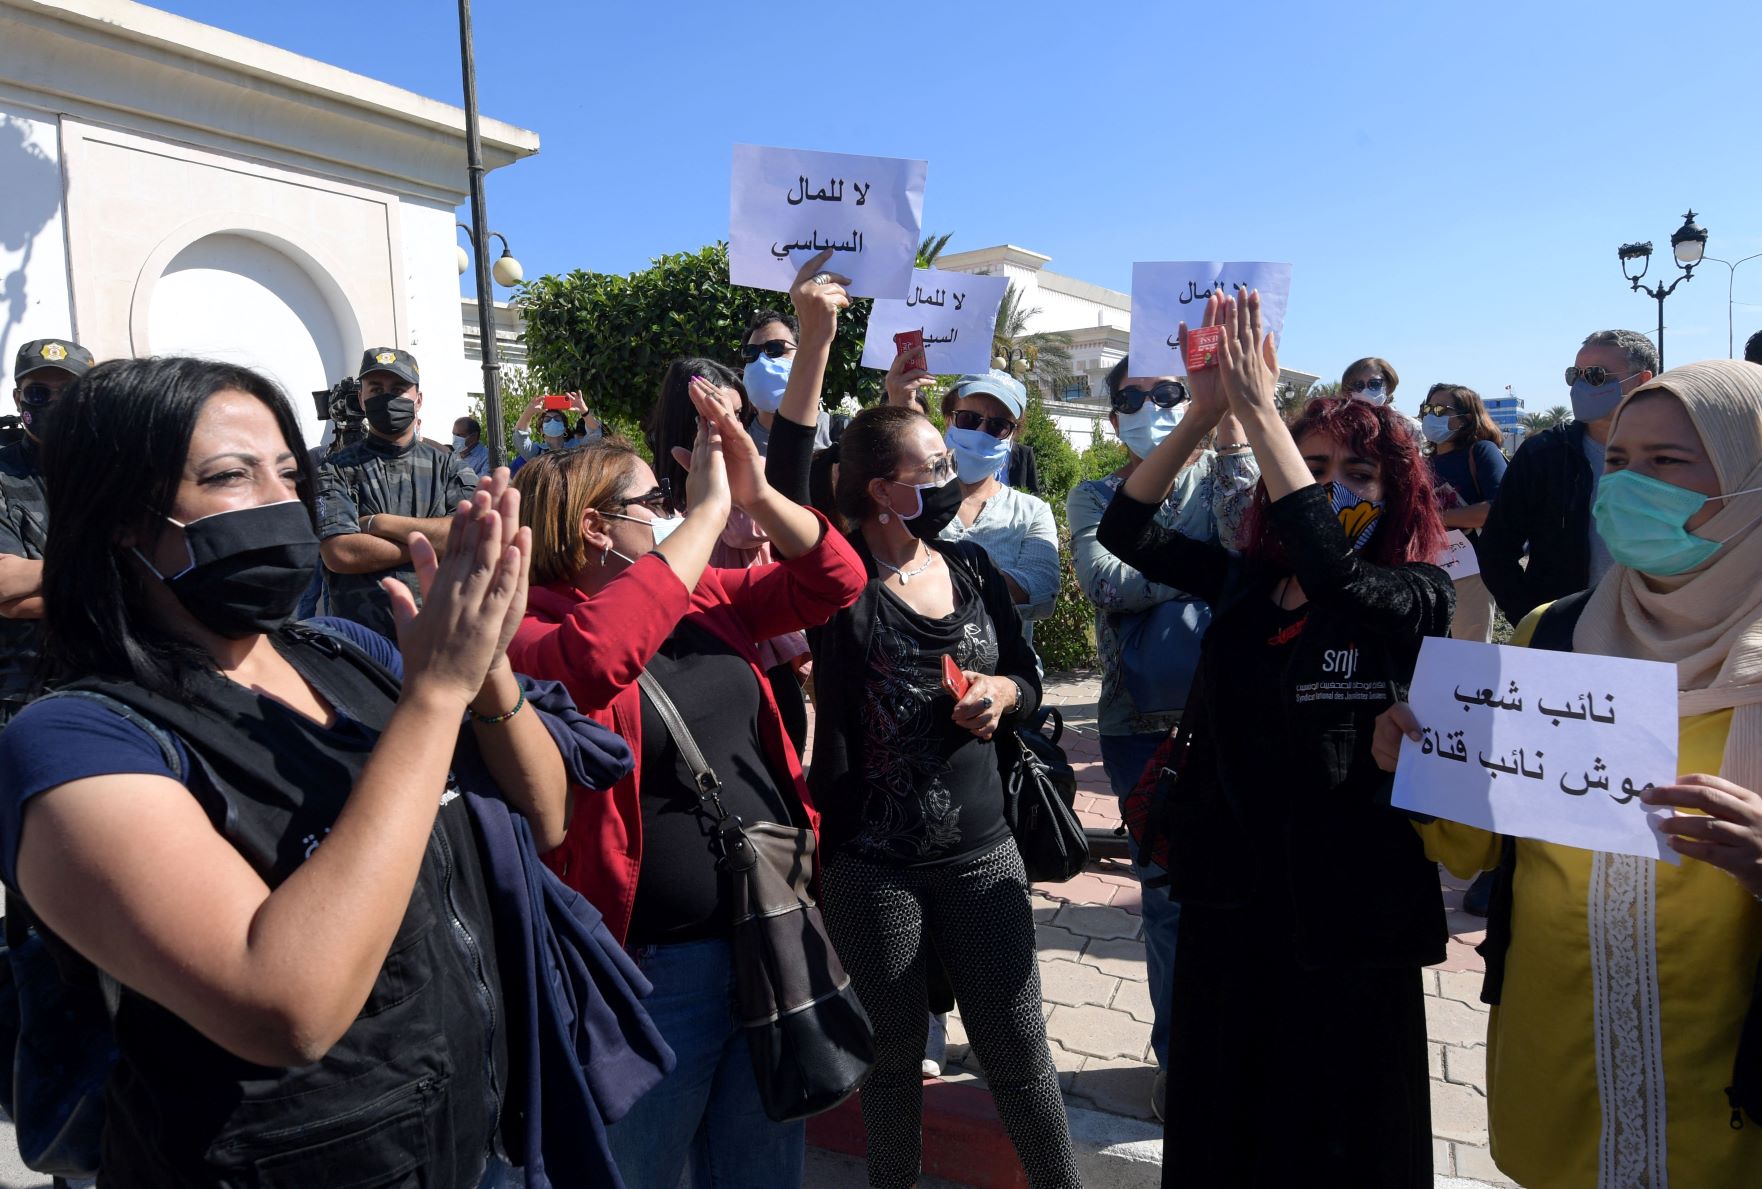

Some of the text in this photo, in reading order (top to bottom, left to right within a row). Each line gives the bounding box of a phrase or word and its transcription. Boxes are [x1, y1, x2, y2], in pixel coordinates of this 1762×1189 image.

[787, 175, 871, 206] لا للمال
[906, 286, 966, 311] لا للمال
[1453, 680, 1615, 727] نائب شعب
[1421, 727, 1656, 804] موش نائب قناة
